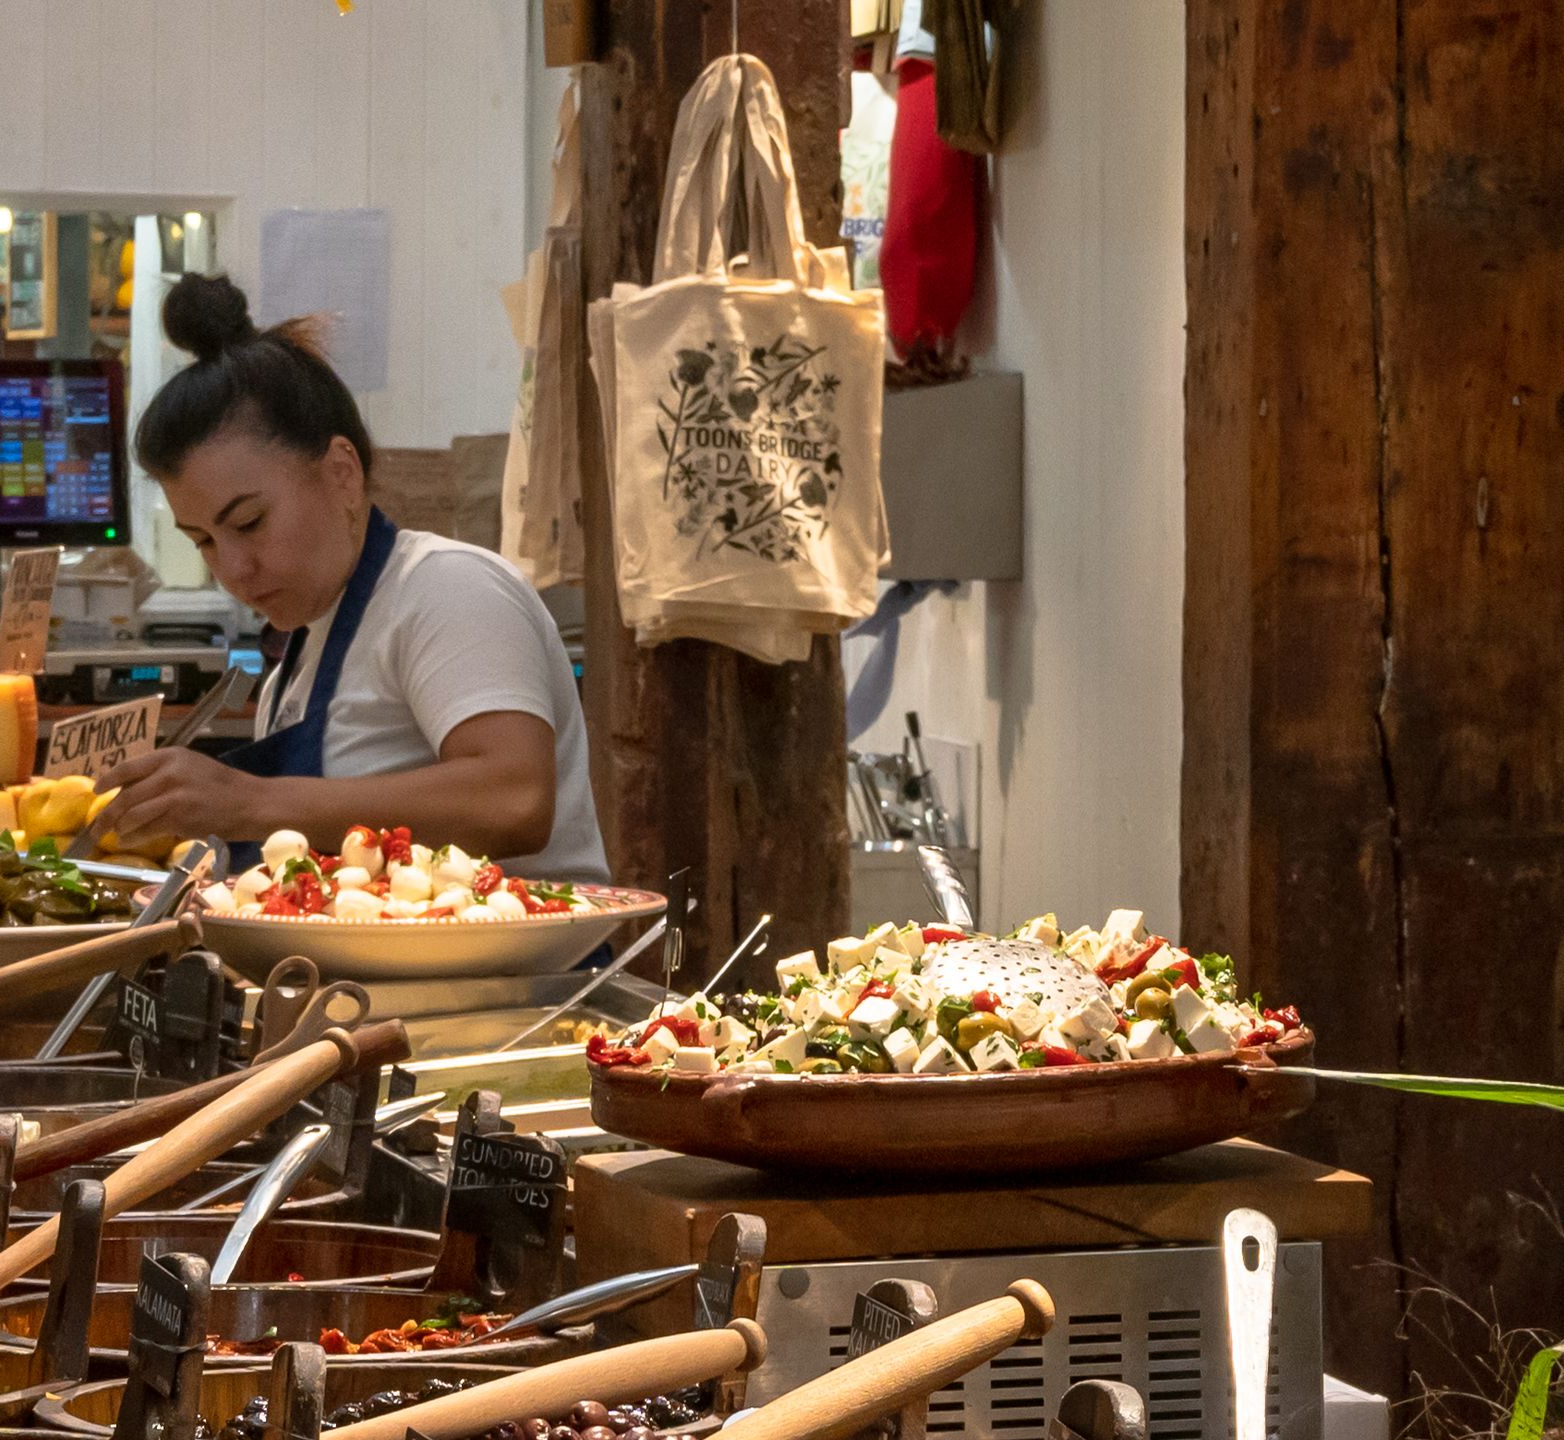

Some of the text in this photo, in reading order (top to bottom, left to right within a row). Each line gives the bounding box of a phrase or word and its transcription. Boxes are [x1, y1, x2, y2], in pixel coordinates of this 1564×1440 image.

[681, 426, 825, 463] TOONS BRIDGE
[715, 452, 795, 481] DAIRY
[50, 706, 148, 766] SCAMORZA
[123, 985, 157, 1033] FETA
[136, 1280, 183, 1338] KALAMATA
[862, 1299, 902, 1341] PITTED
